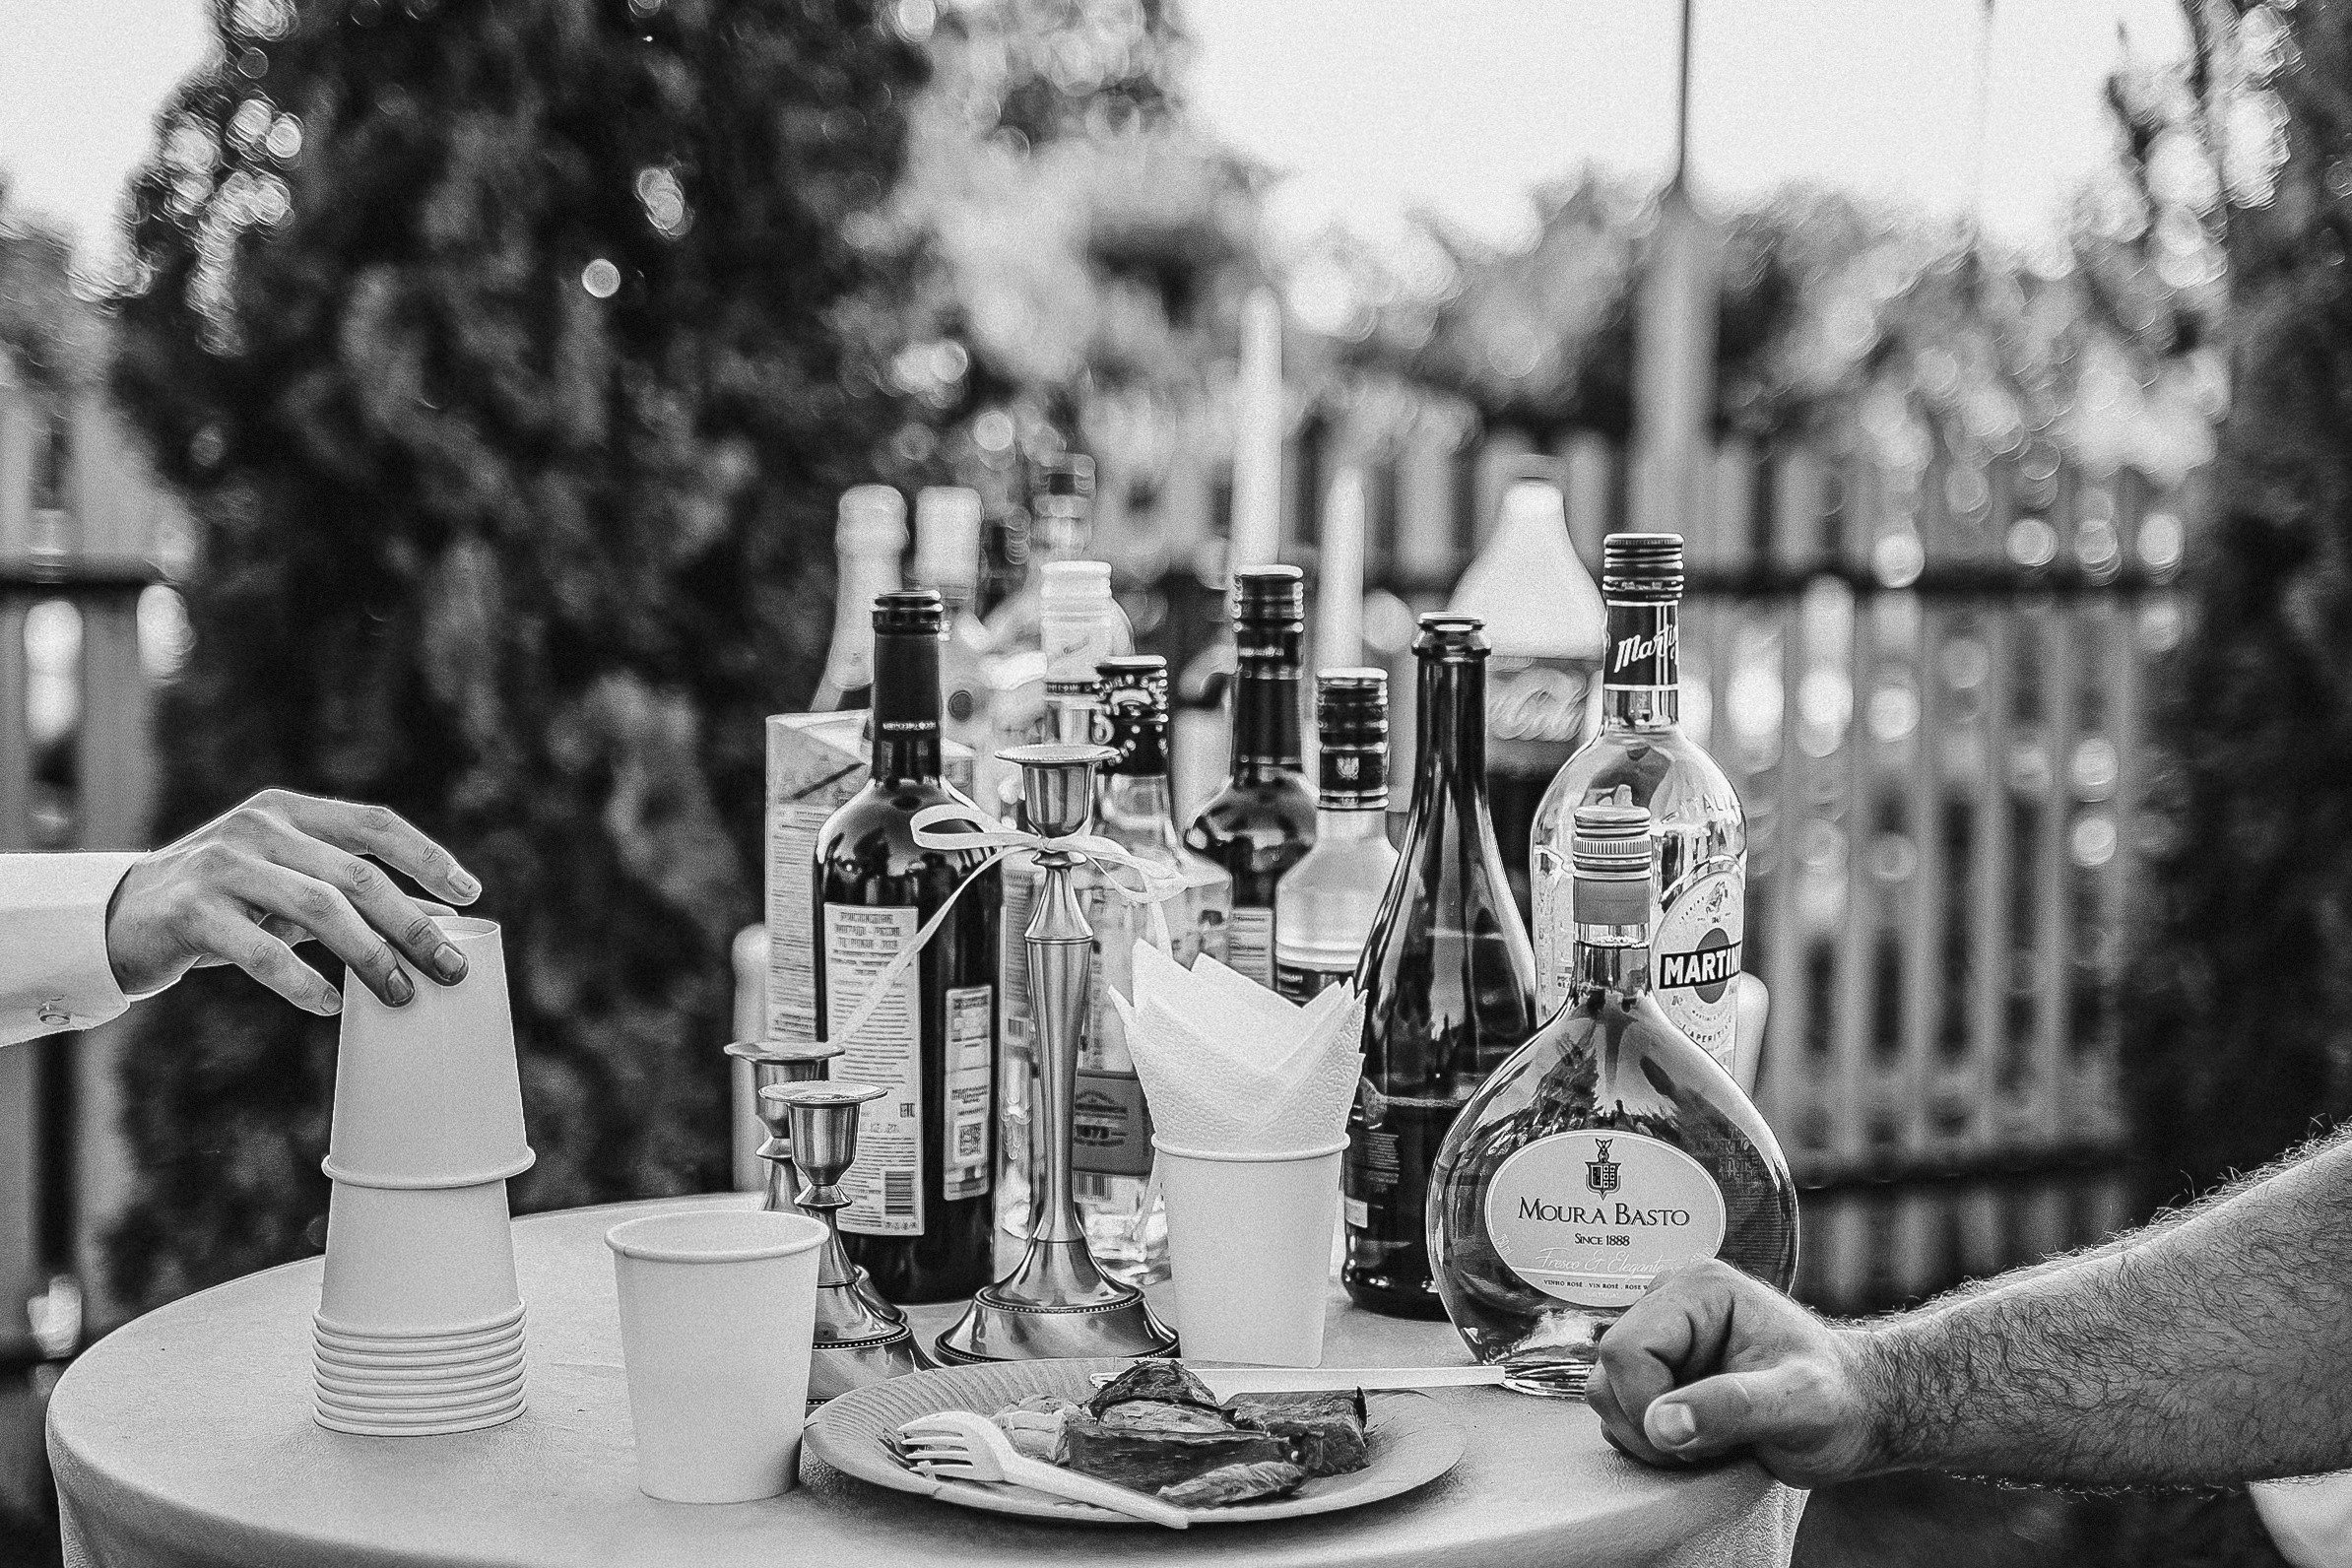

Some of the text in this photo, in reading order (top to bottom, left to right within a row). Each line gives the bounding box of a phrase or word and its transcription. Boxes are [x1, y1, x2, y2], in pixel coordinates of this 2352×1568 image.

[1518, 1196, 1690, 1226] MOURA BASTO
[1574, 1232, 1630, 1247] SINCE 1888
[1535, 1246, 1580, 1270] Fresco
[1606, 1249, 1674, 1280] Elegante
